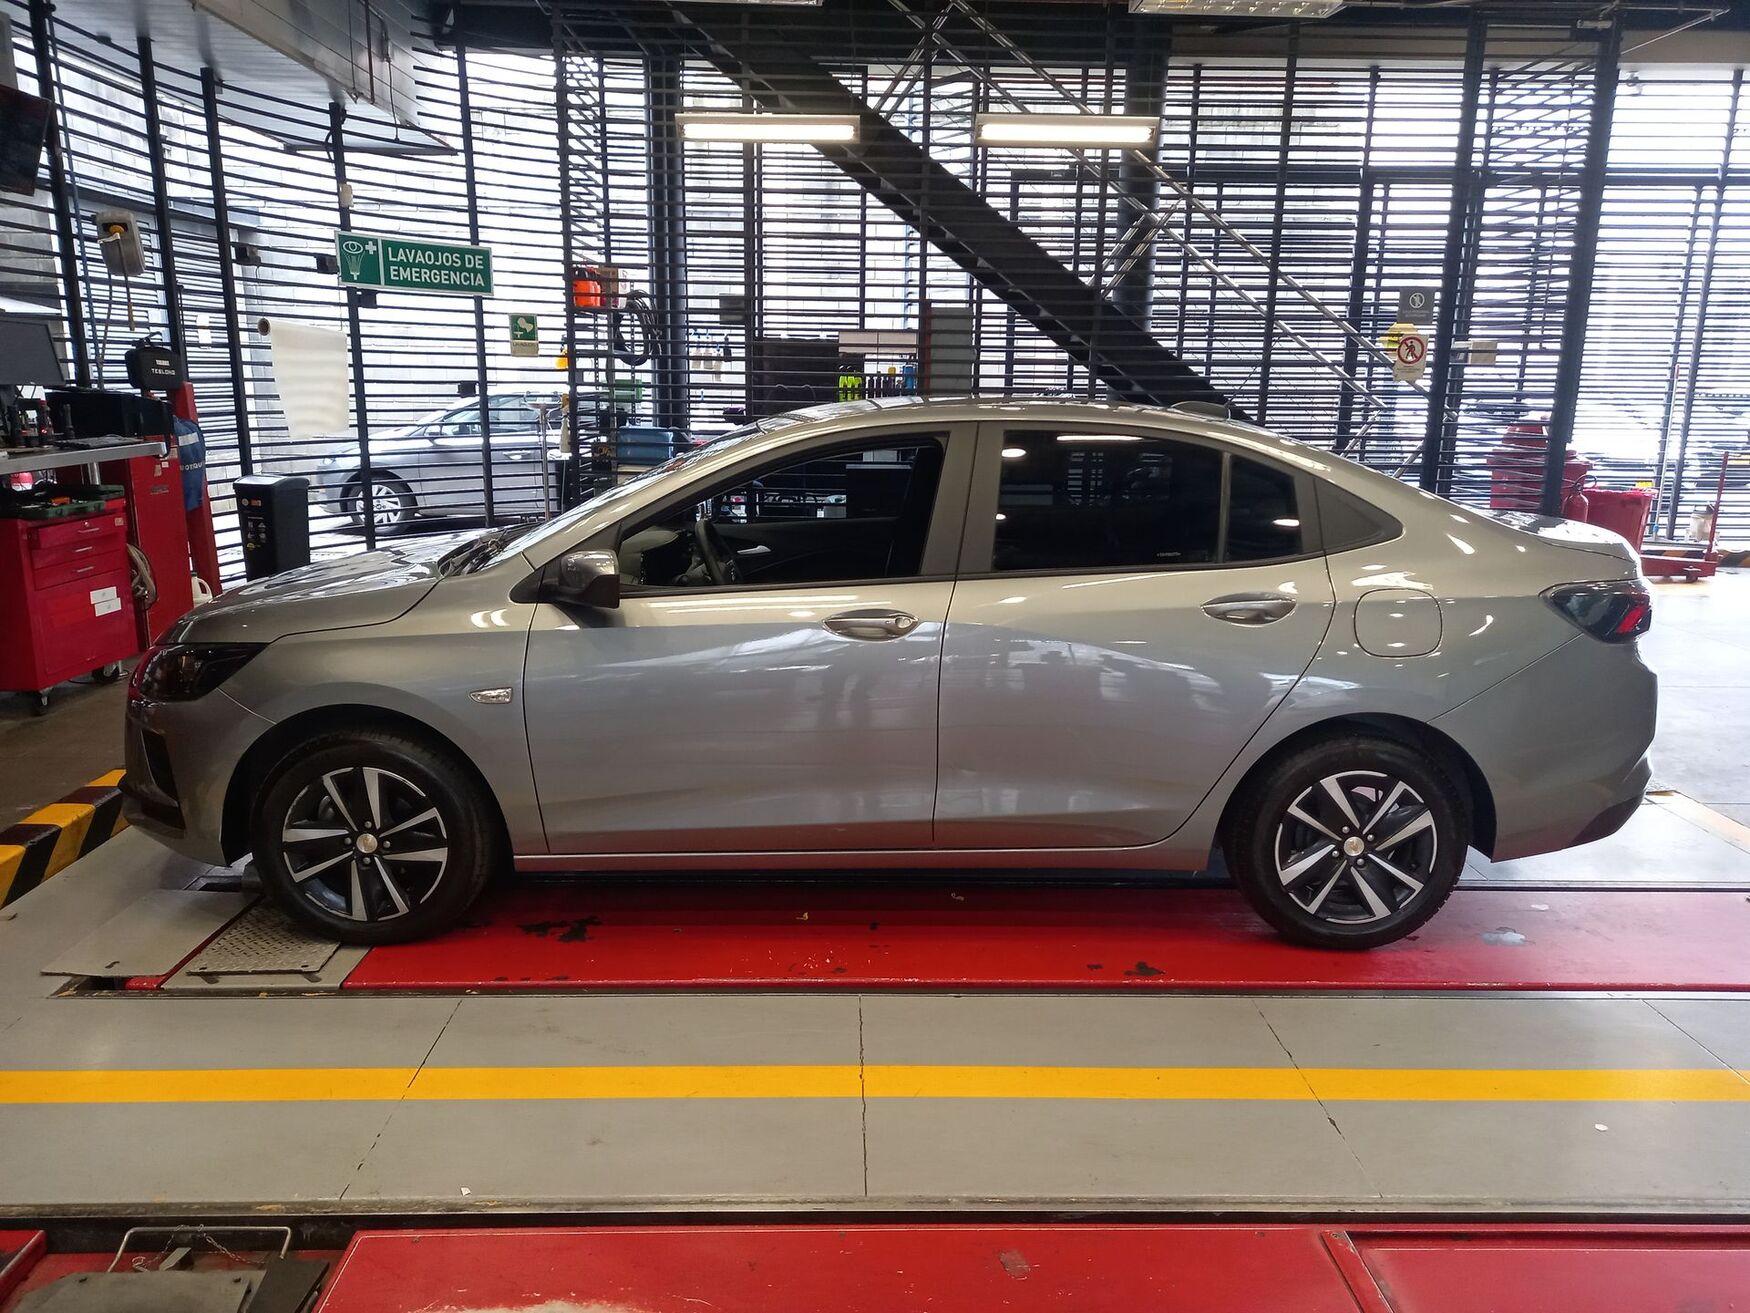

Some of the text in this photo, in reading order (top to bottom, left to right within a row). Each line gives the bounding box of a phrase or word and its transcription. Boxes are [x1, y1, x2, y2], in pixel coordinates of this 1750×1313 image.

[387, 246, 484, 269] LAVAOJOS DE
[390, 265, 485, 287] EMERGENCIA
